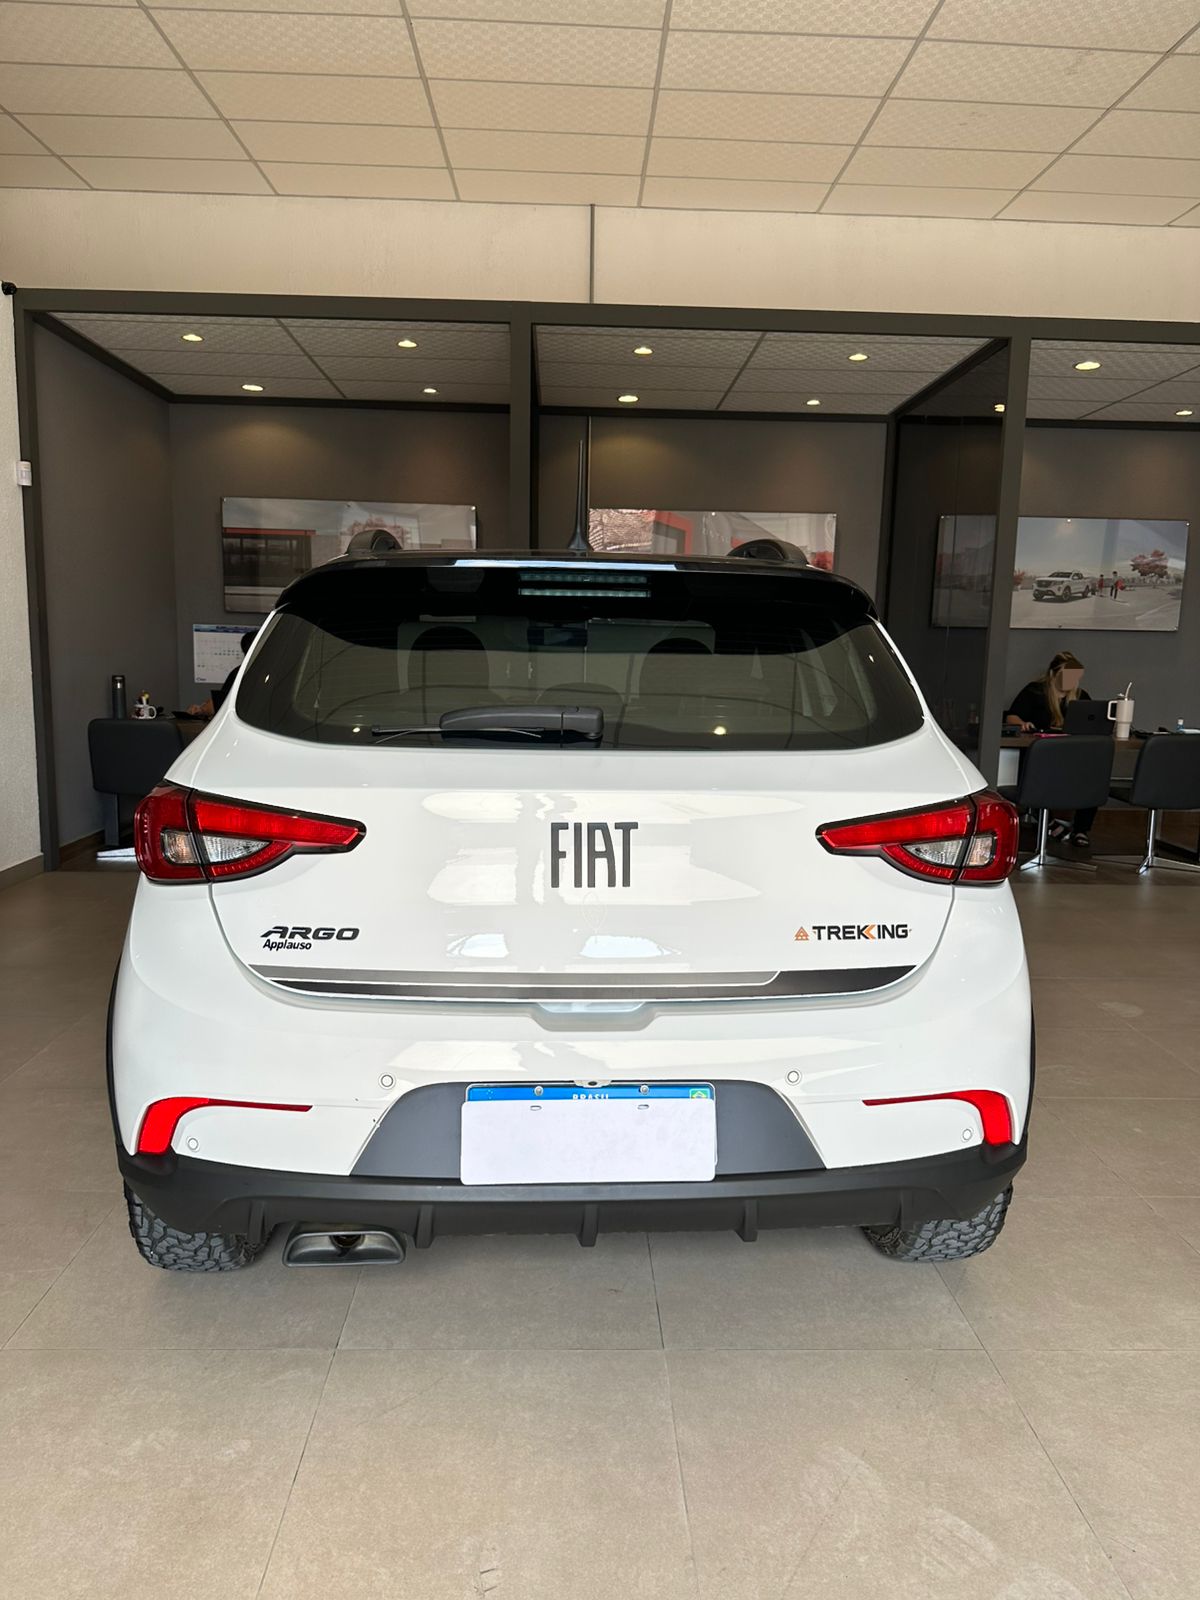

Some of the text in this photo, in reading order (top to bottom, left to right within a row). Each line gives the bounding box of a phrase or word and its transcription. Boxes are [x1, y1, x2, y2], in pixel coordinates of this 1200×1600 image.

[550, 822, 639, 888] FIAT
[260, 925, 360, 940] ARGO
[262, 938, 312, 952] Applauso
